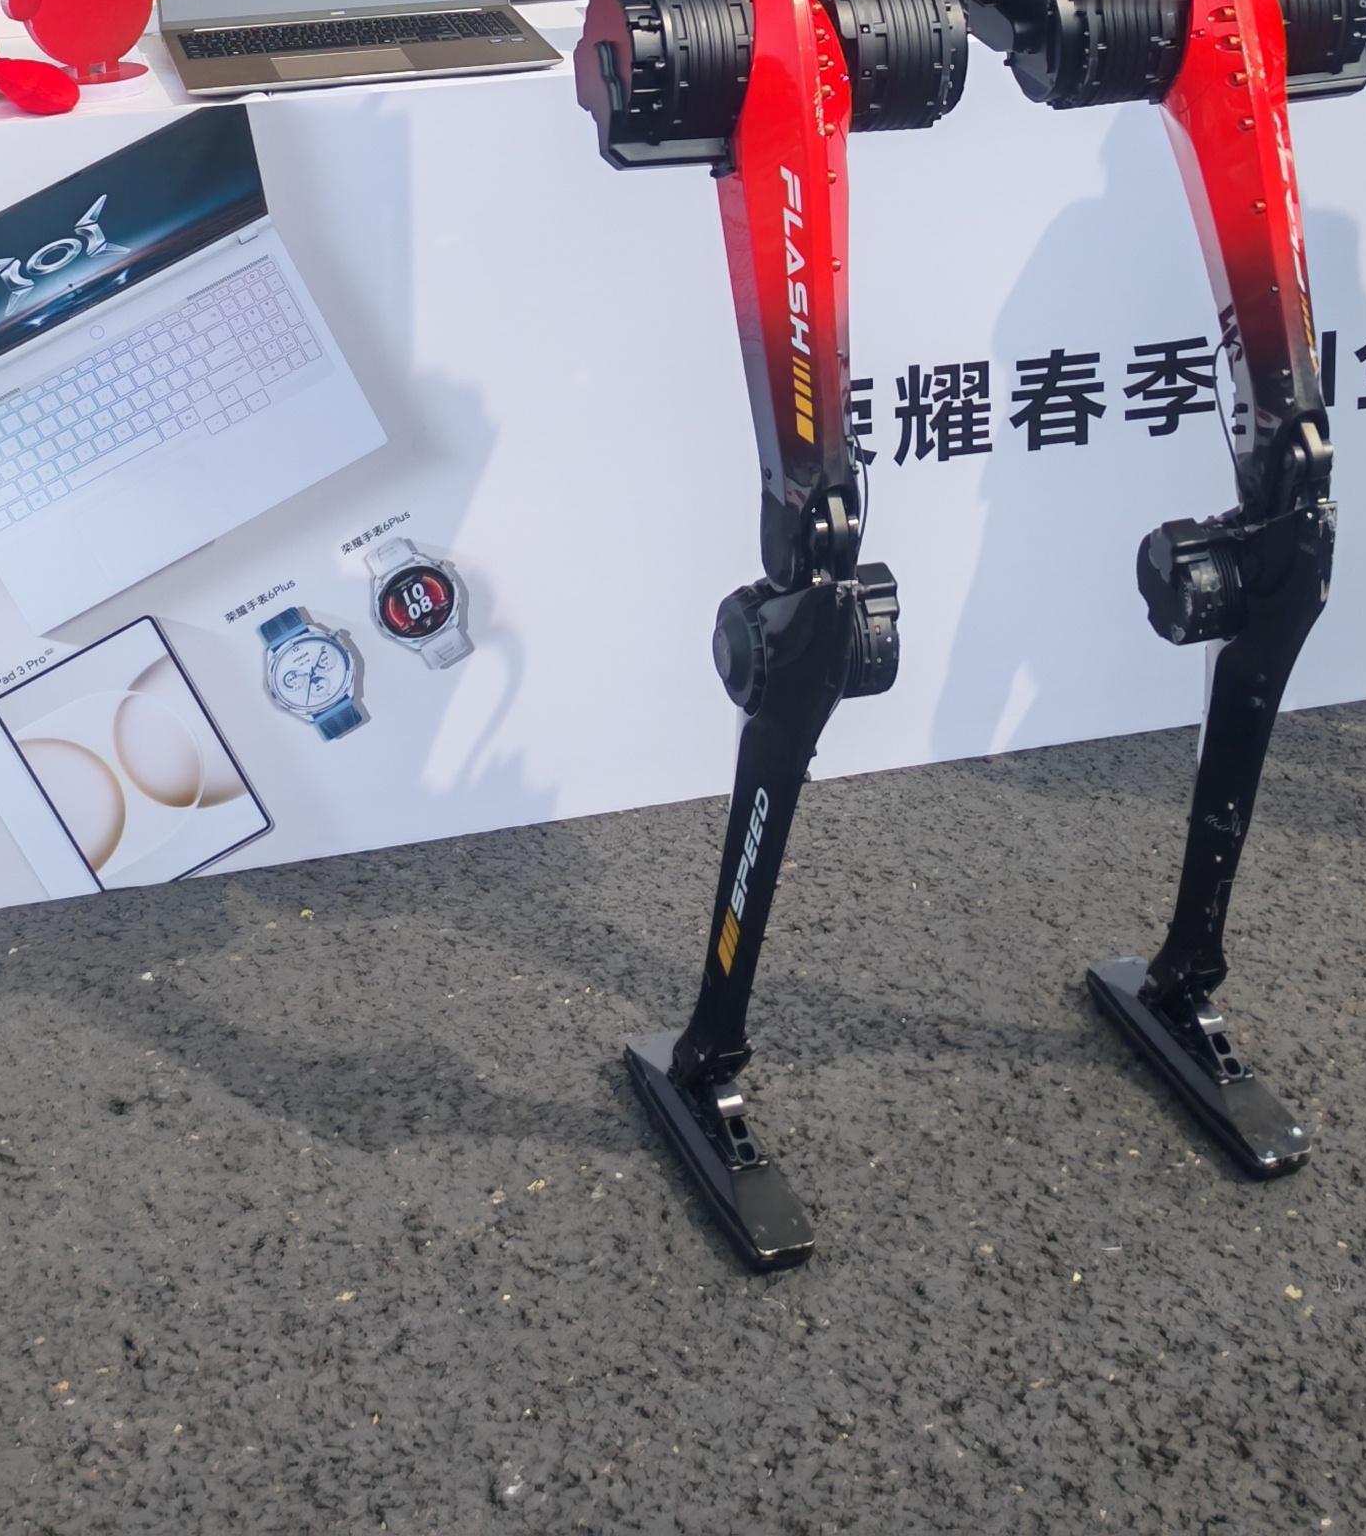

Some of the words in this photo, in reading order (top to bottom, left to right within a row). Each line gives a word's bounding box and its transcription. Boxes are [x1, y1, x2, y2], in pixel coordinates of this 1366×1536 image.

[778, 165, 812, 355] FLASH
[402, 582, 425, 606] 10
[408, 595, 433, 620] 08
[16, 665, 26, 676] 3
[25, 655, 47, 671] Pro
[729, 786, 771, 921] SPEED
